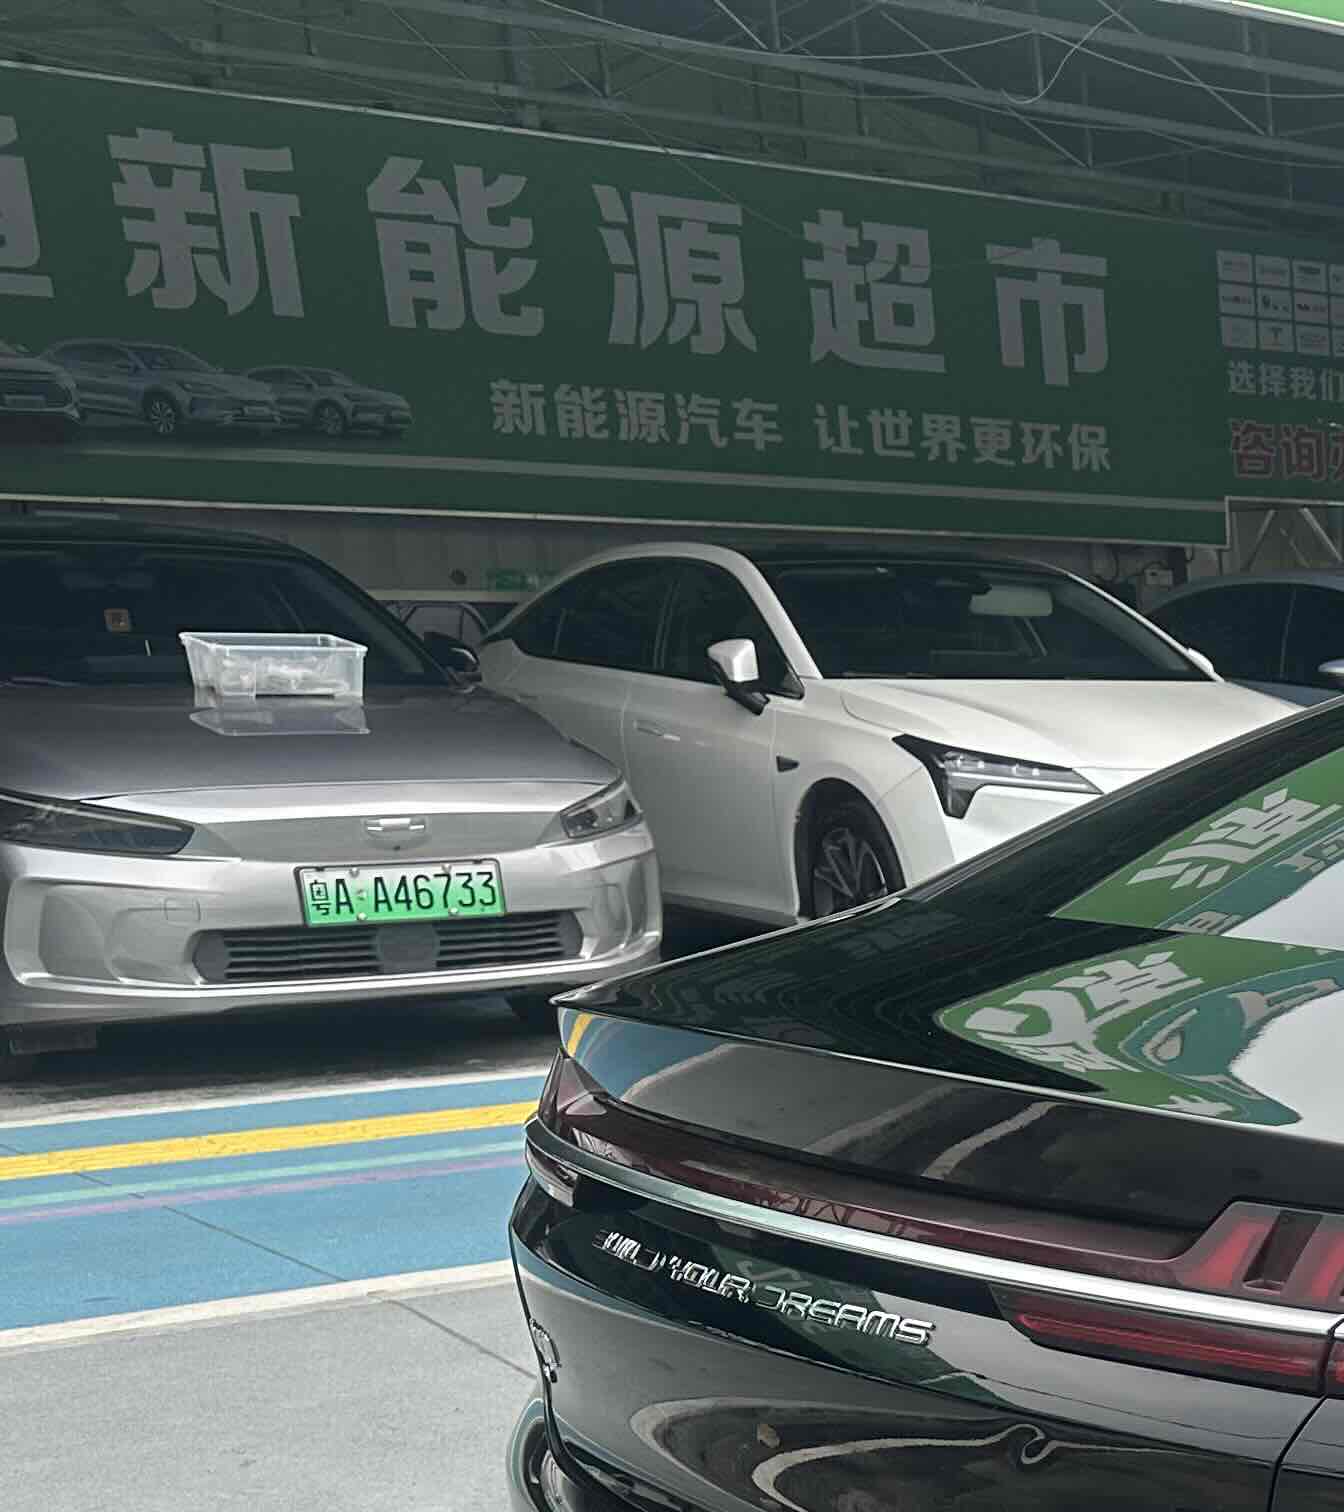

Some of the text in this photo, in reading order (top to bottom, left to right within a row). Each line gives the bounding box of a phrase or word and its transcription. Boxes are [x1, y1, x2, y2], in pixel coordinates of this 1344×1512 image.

[1227, 359, 1344, 404] 选择我们
[490, 378, 1112, 473] 新能源汽车 让世界更环保
[754, 1284, 936, 1347] DREAMS
